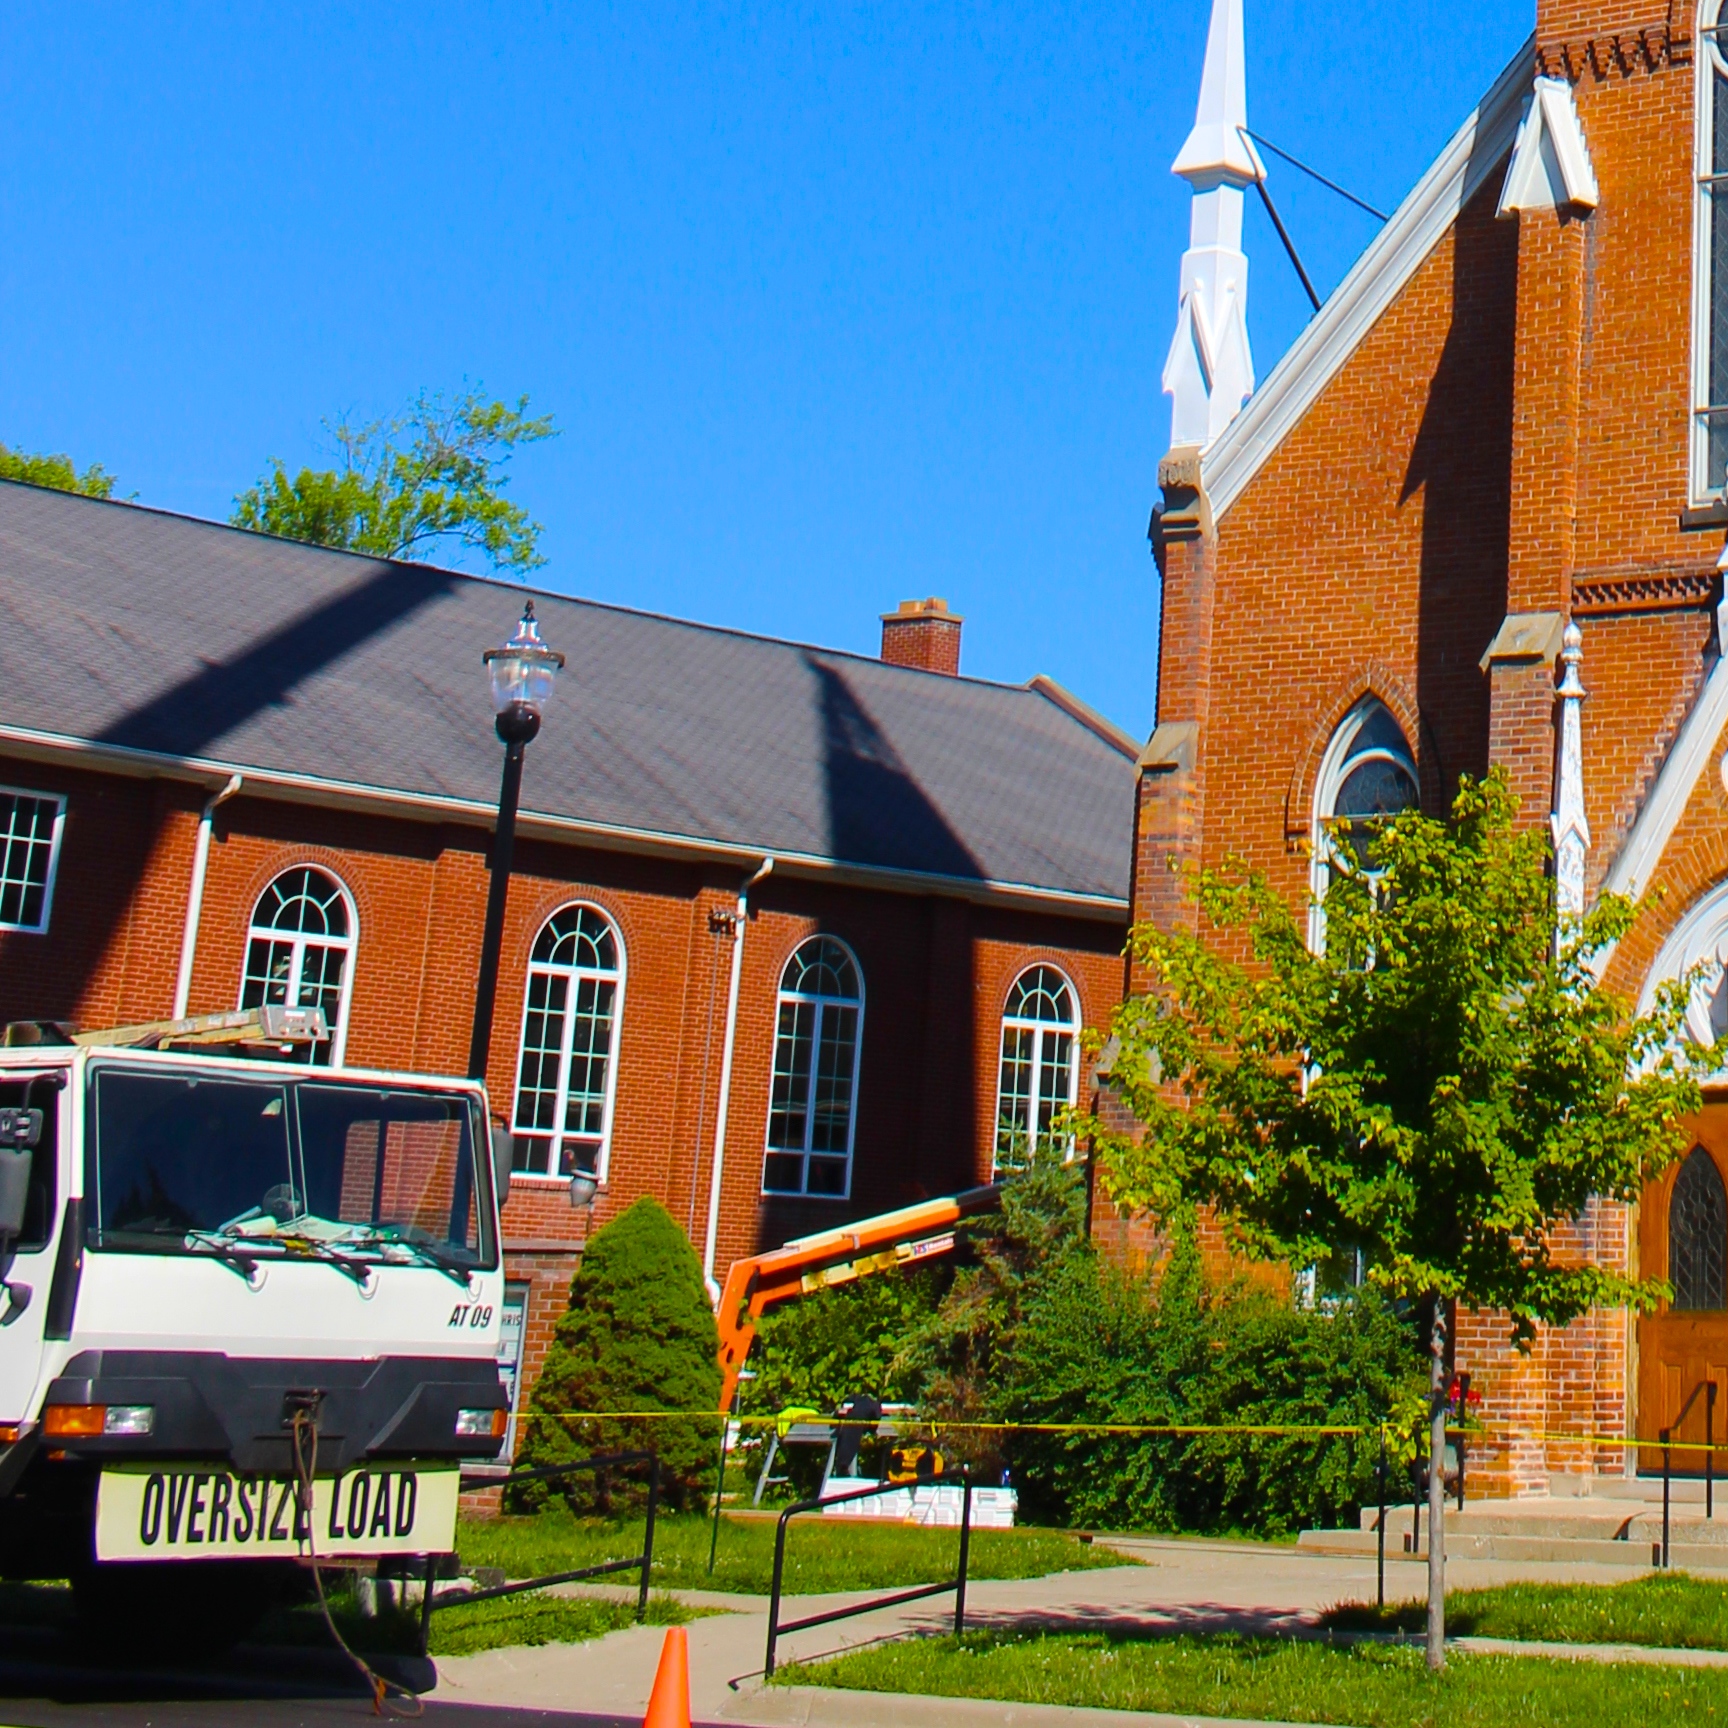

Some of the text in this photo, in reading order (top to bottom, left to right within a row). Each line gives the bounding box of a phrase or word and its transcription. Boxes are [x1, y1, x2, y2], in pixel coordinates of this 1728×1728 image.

[447, 1304, 493, 1328] AT 09
[328, 1471, 418, 1539] LOAD
